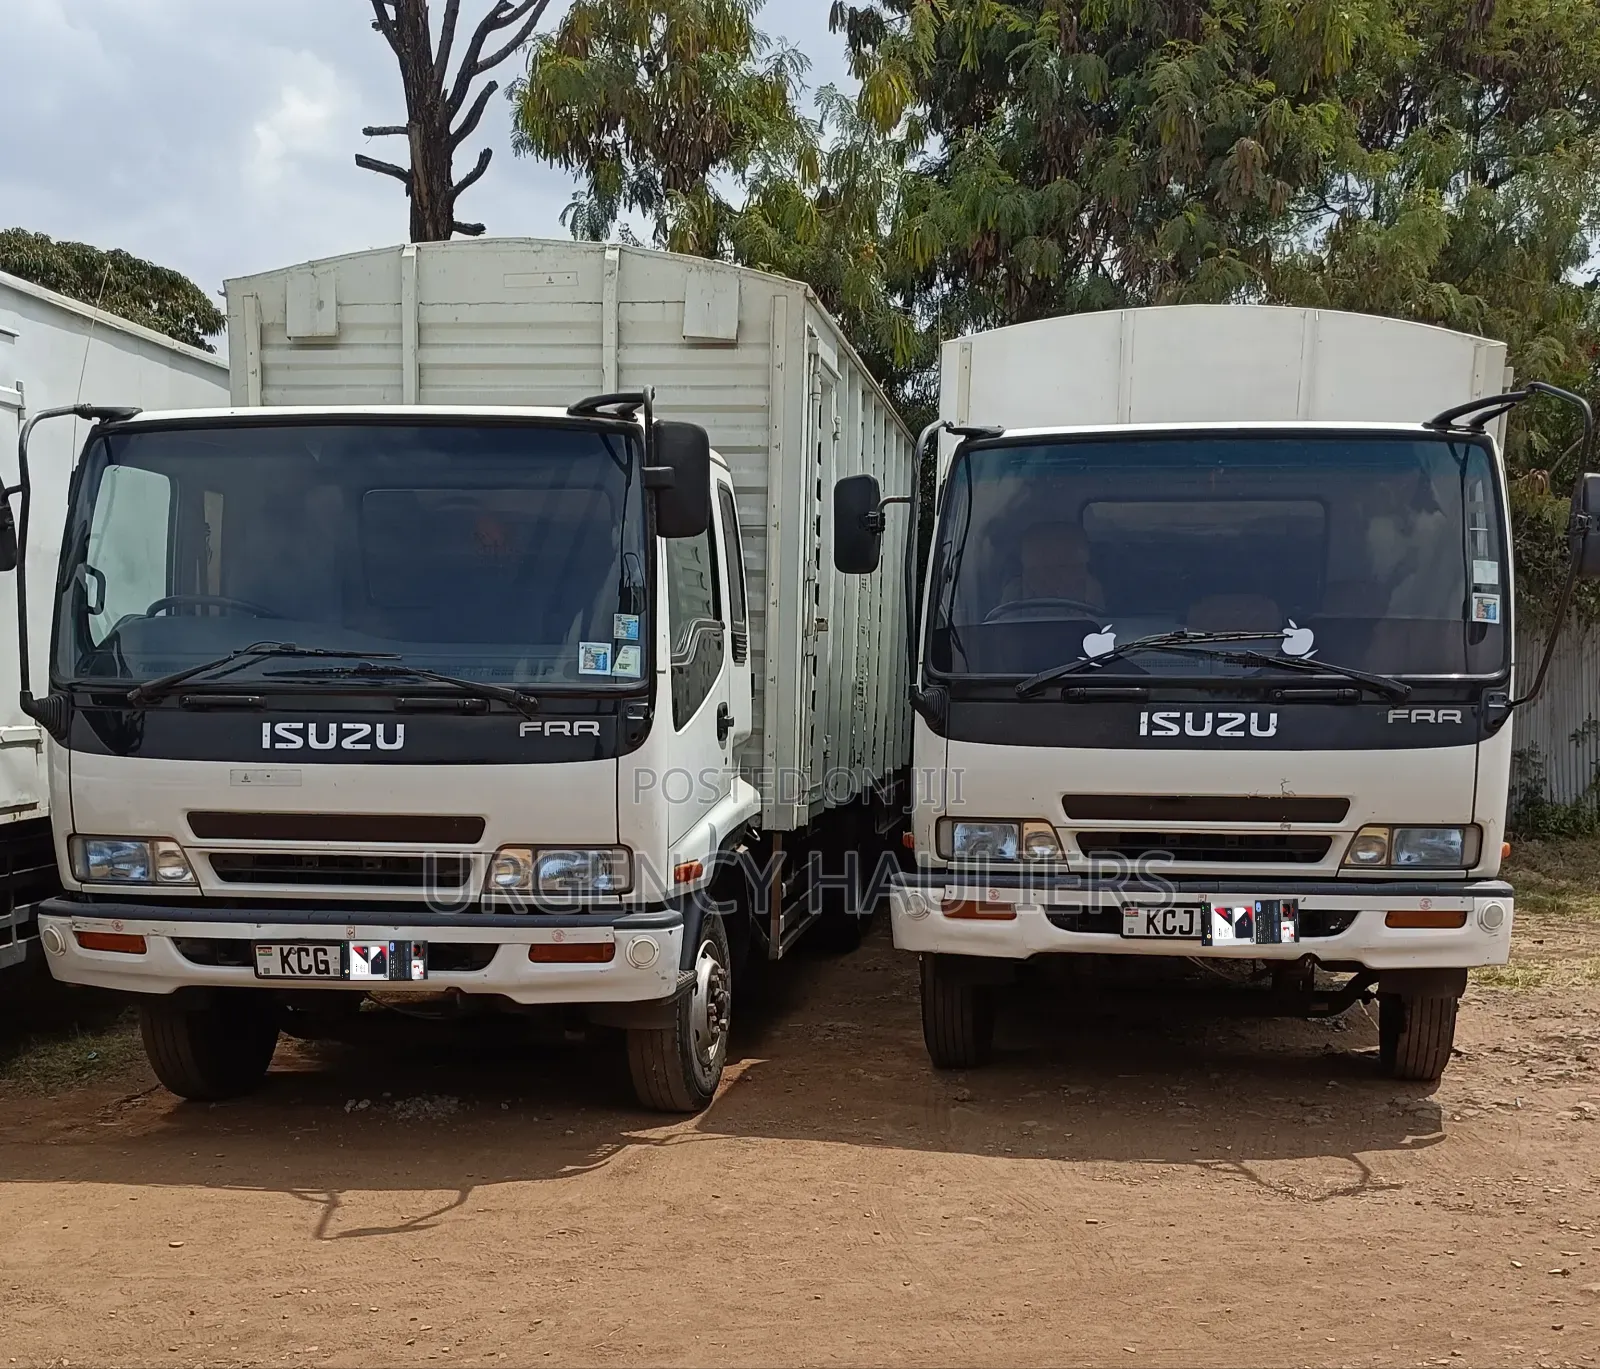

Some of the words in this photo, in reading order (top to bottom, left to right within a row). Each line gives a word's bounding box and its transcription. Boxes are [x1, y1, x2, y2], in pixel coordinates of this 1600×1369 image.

[518, 721, 601, 738] FRR
[1138, 711, 1278, 738] ISUZU
[1386, 709, 1463, 724] FRR
[261, 722, 406, 750] ISUZU
[1145, 909, 1195, 935] KCJ
[279, 946, 331, 975] KCG
